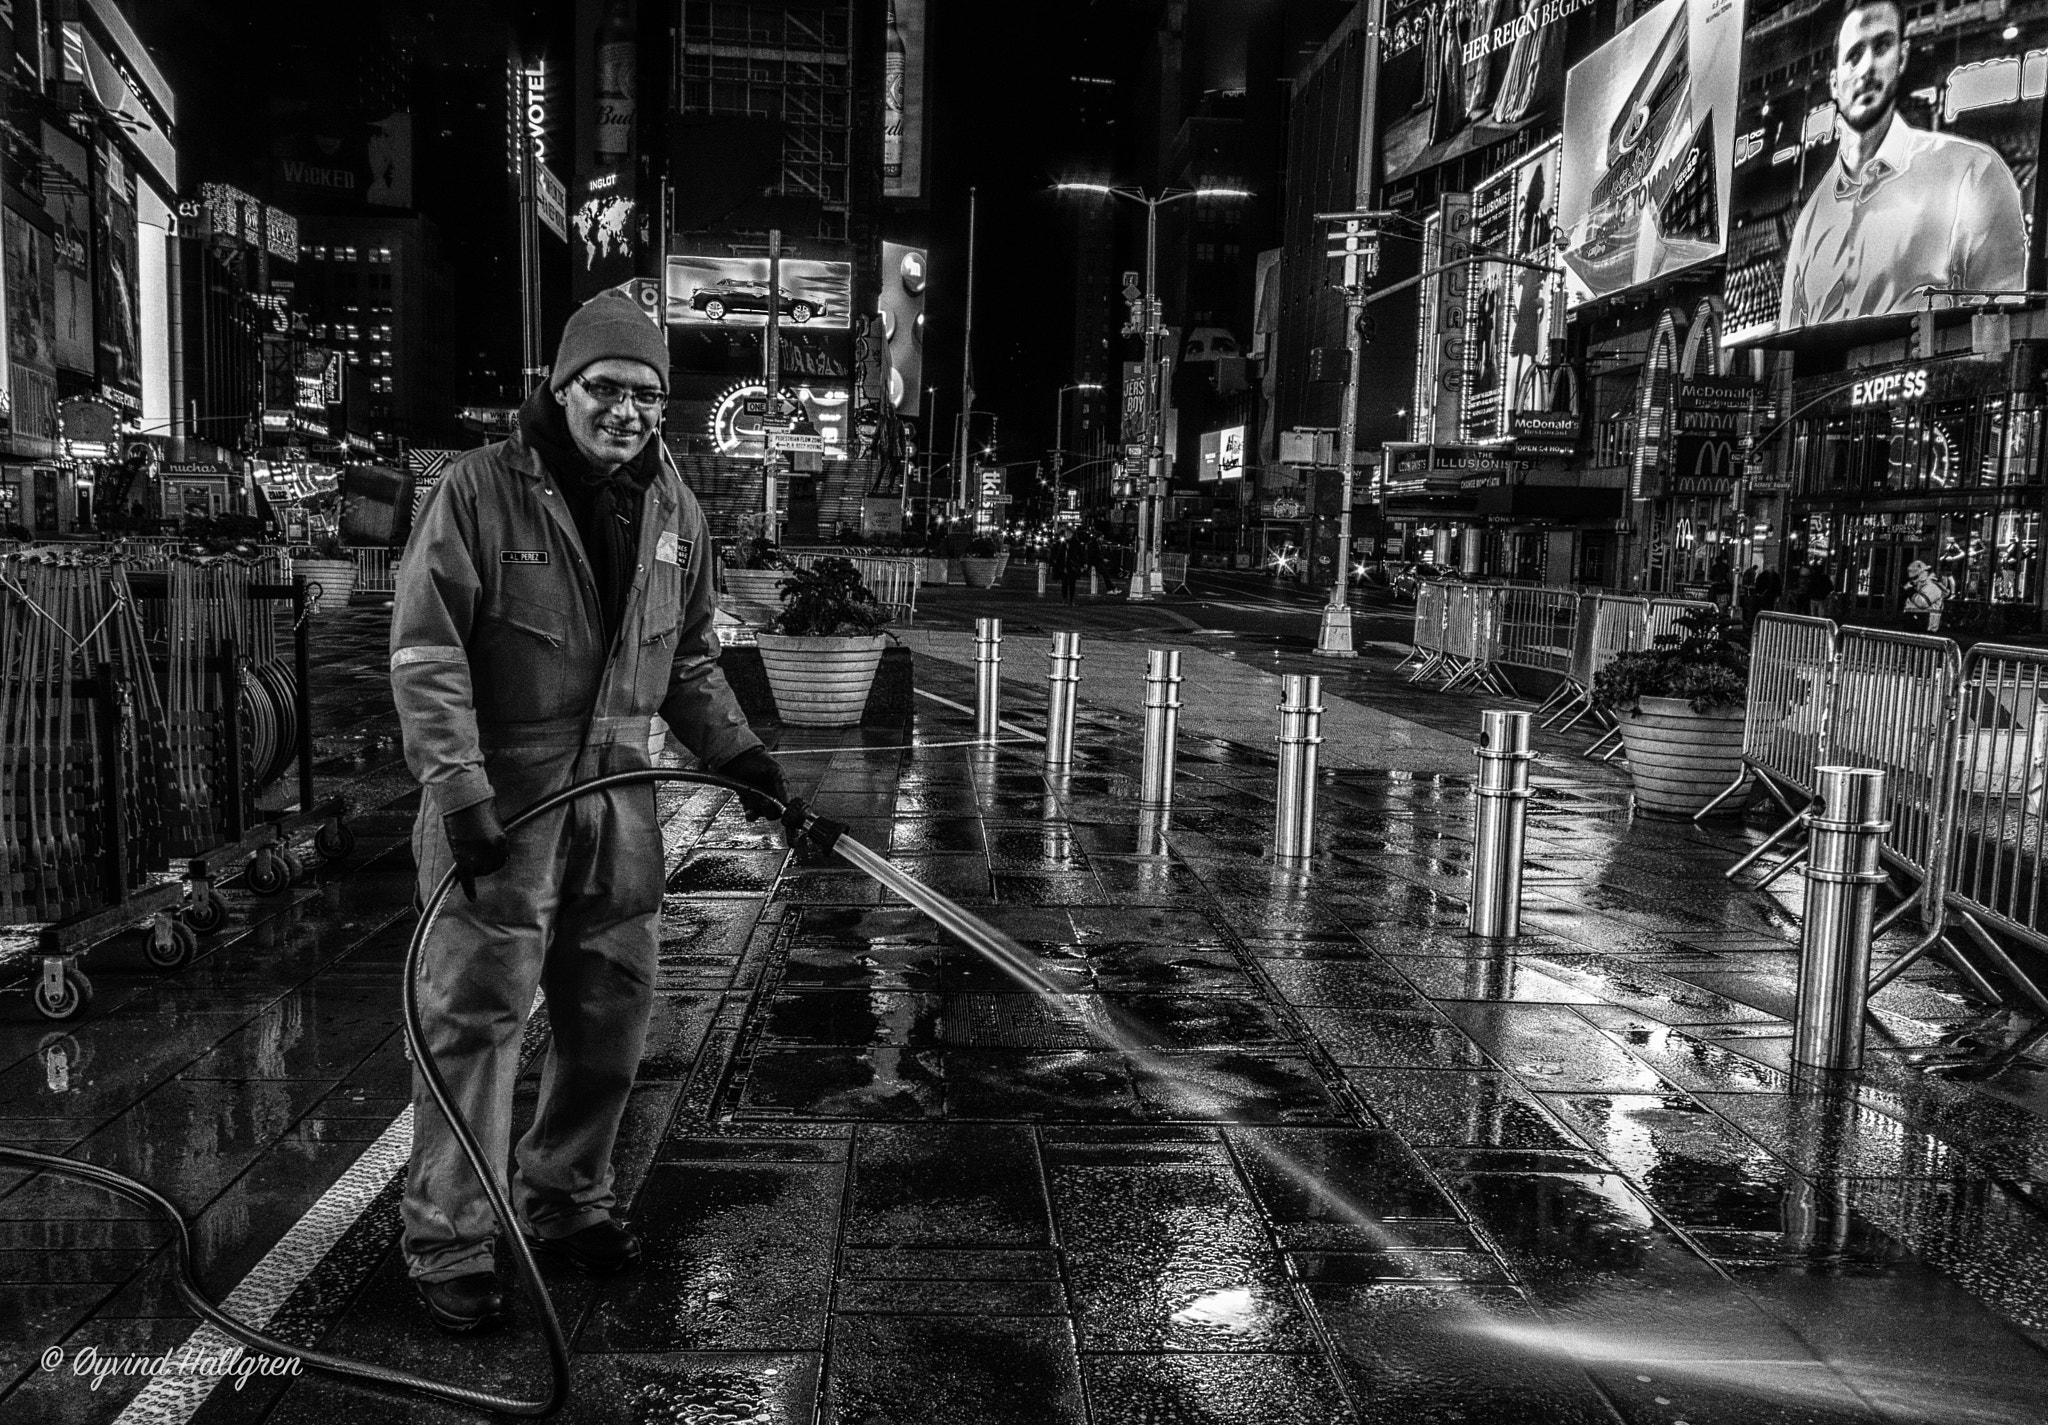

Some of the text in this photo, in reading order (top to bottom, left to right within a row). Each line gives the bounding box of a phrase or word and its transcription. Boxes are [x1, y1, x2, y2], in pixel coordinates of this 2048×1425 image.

[1462, 33, 1490, 66] HER
[1492, 7, 1540, 51] REIGN
[1541, 0, 1595, 27] BEGI
[525, 60, 545, 163] OVOTEL
[282, 160, 355, 189] WICKED
[589, 173, 619, 191] INGLOT
[1123, 375, 1157, 398] JERSY
[1681, 385, 1764, 399] McDonald's
[749, 403, 765, 412] ONE
[1127, 395, 1146, 413] BOY
[1514, 418, 1580, 430] McDonald's
[169, 462, 217, 473] nuchas
[1436, 458, 1529, 470] ILLUSIONISTS
[520, 553, 539, 561] PEREZ
